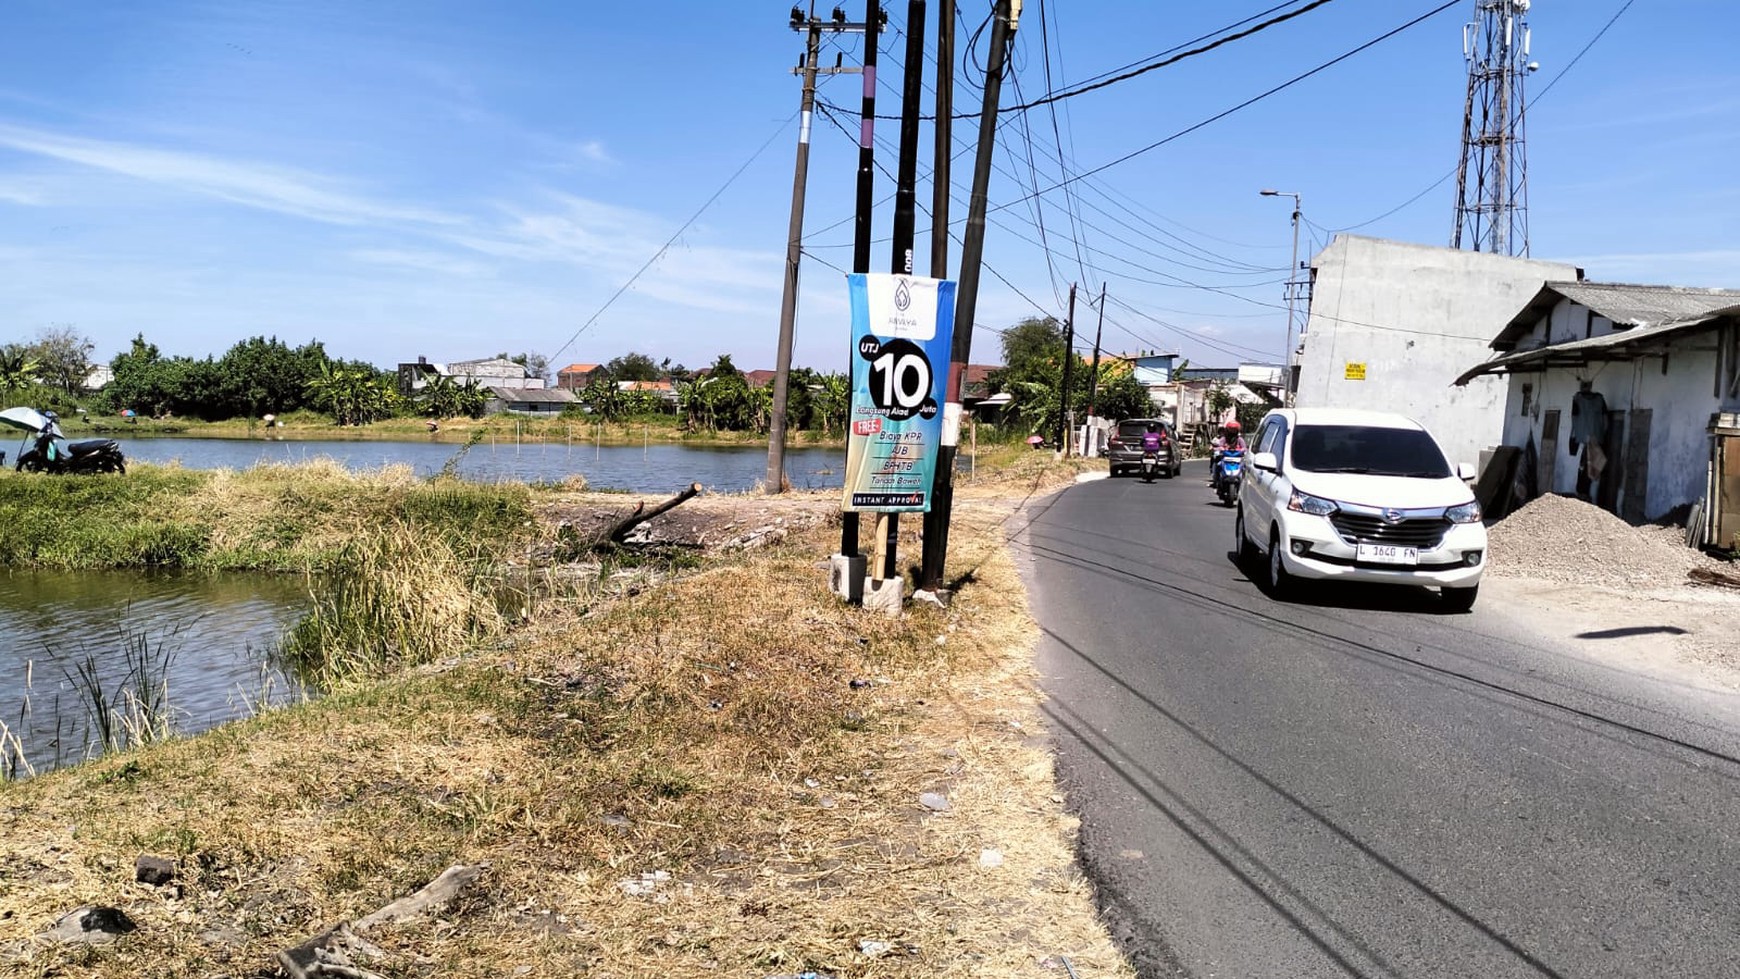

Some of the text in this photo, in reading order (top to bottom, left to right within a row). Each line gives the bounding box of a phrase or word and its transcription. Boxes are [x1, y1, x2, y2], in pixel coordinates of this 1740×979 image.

[860, 342, 880, 353] UTJ
[873, 353, 929, 407] 10
[919, 404, 937, 413] Juta
[858, 419, 877, 433] FREE
[904, 432, 923, 440] KPR
[853, 496, 885, 504] INSTANT
[1360, 545, 1365, 554] L
